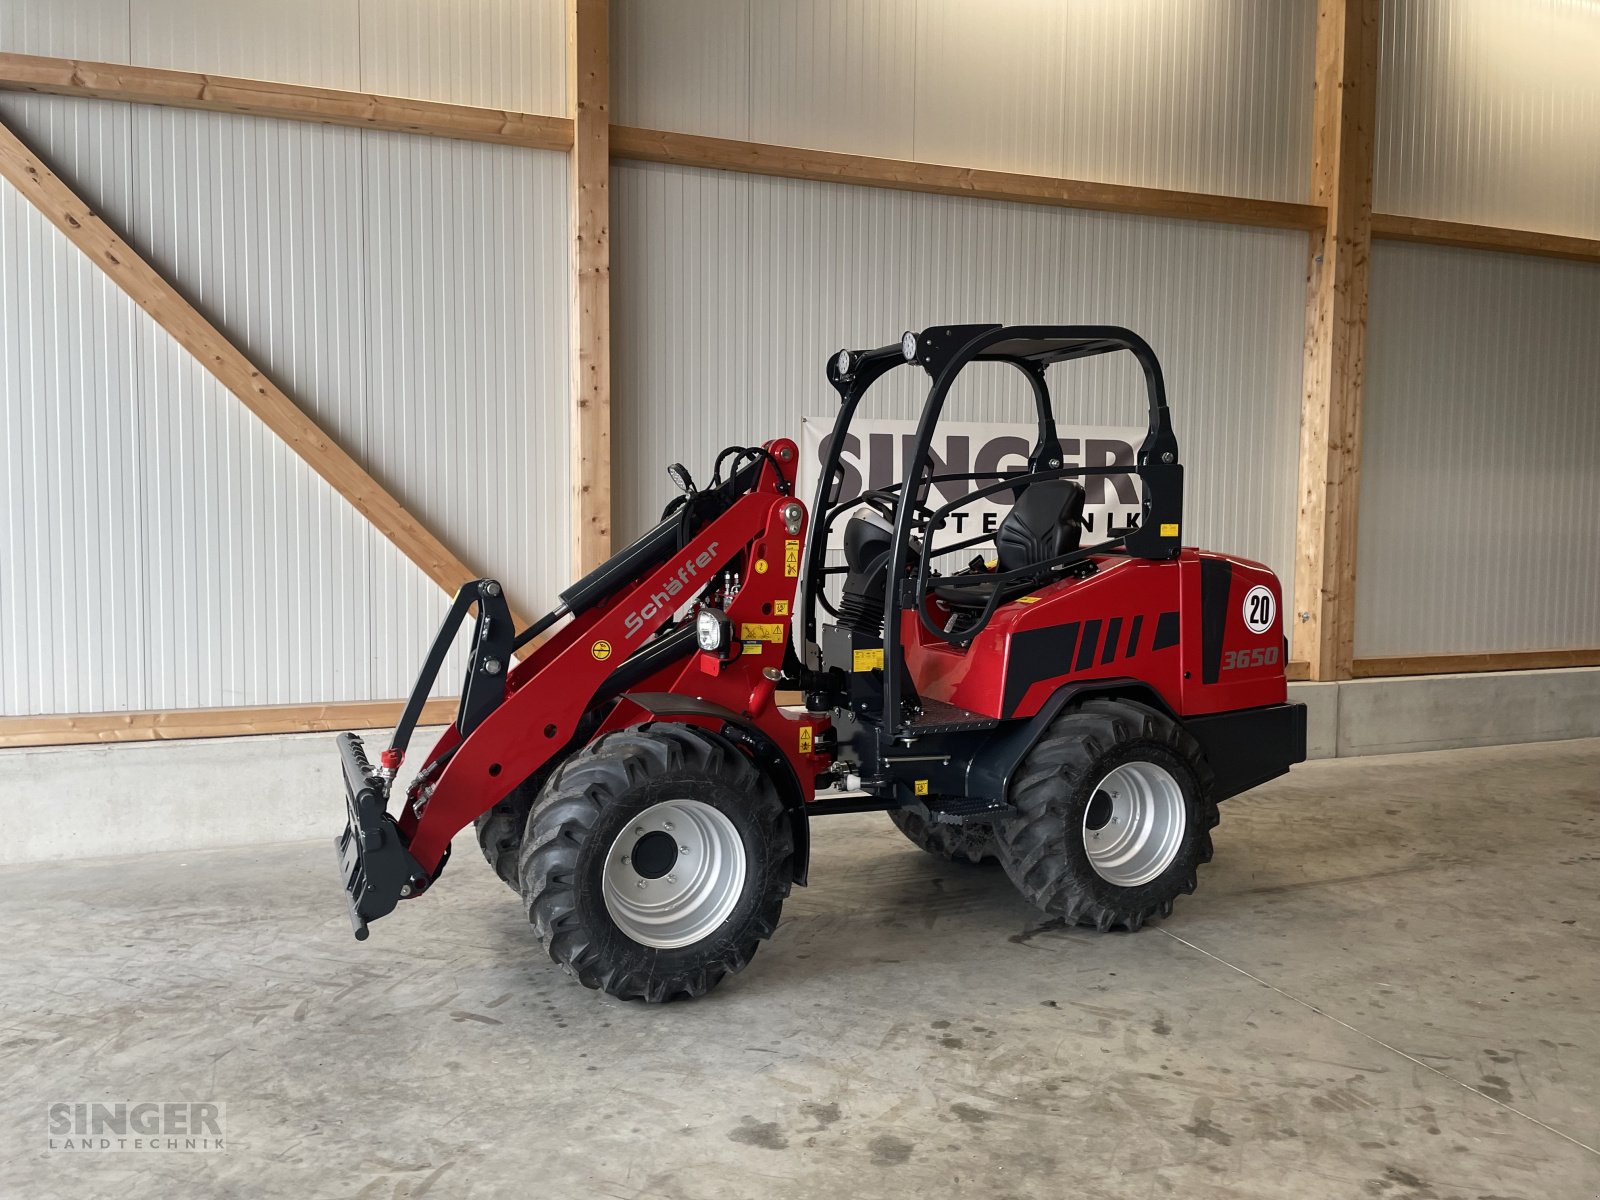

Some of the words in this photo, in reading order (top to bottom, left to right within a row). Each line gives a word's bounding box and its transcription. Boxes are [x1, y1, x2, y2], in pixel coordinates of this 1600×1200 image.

[624, 541, 719, 639] Schäffer
[1250, 595, 1270, 625] 20
[1222, 646, 1279, 671] 3650
